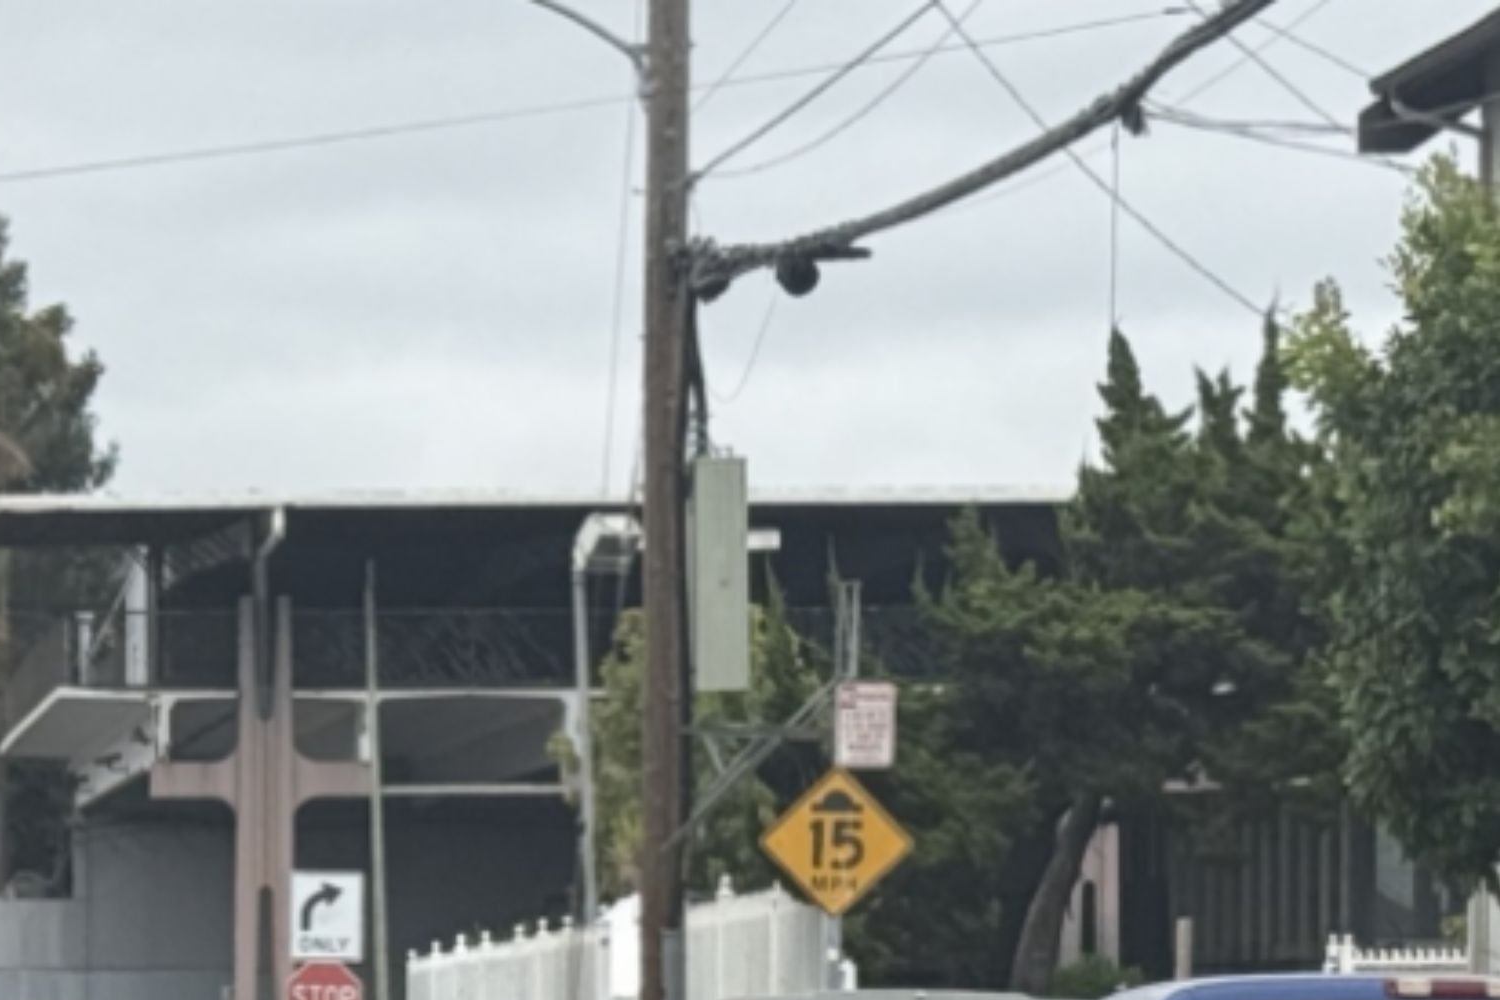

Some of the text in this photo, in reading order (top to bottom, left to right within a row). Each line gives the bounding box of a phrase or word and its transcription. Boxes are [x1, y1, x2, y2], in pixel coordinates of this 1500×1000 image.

[810, 819, 864, 869] 15
[812, 875, 856, 892] MPH
[299, 936, 350, 953] ONLY
